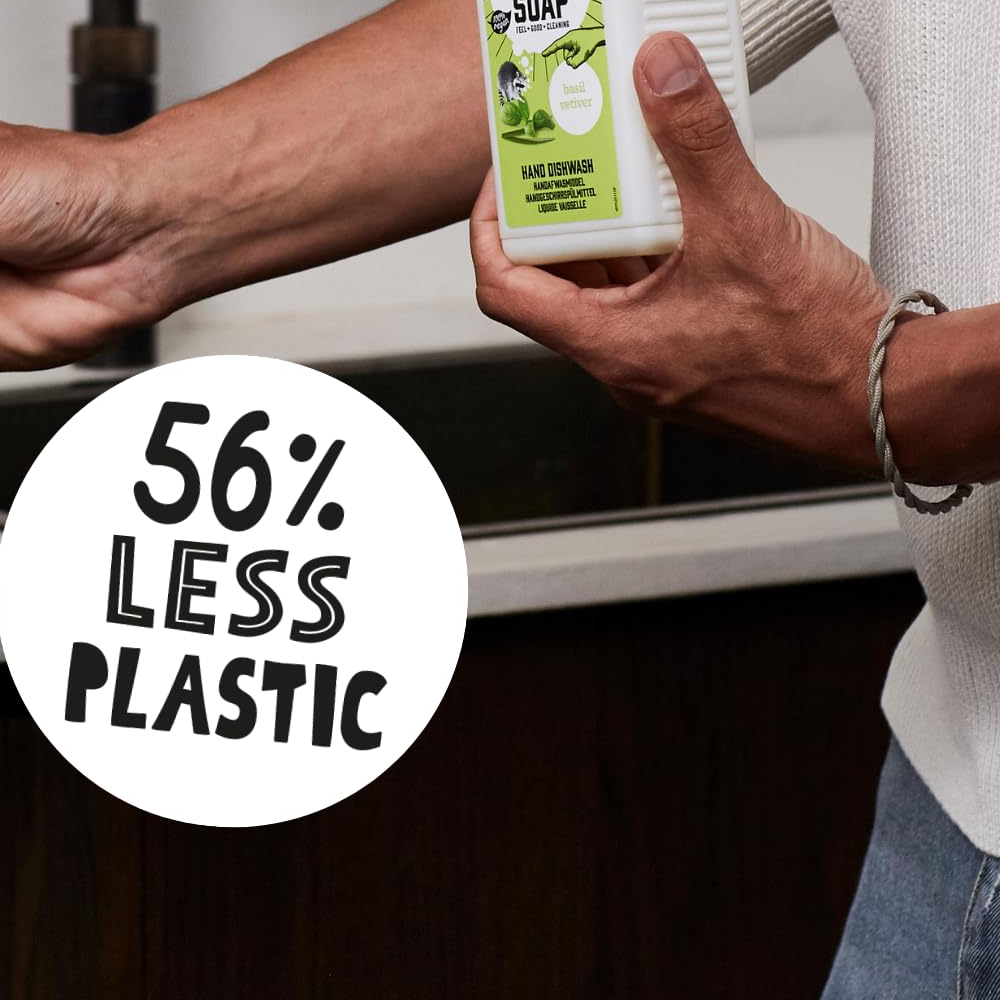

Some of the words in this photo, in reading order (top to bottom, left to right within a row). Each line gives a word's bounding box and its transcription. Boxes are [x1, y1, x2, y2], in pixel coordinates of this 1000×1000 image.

[516, 26, 527, 34] FEEL
[531, 24, 543, 32] GOOD
[547, 20, 570, 30] CLEANING
[563, 81, 586, 95] basil
[560, 97, 592, 111] vetiver
[521, 163, 546, 180] HAND
[547, 158, 594, 177] DISHWASH
